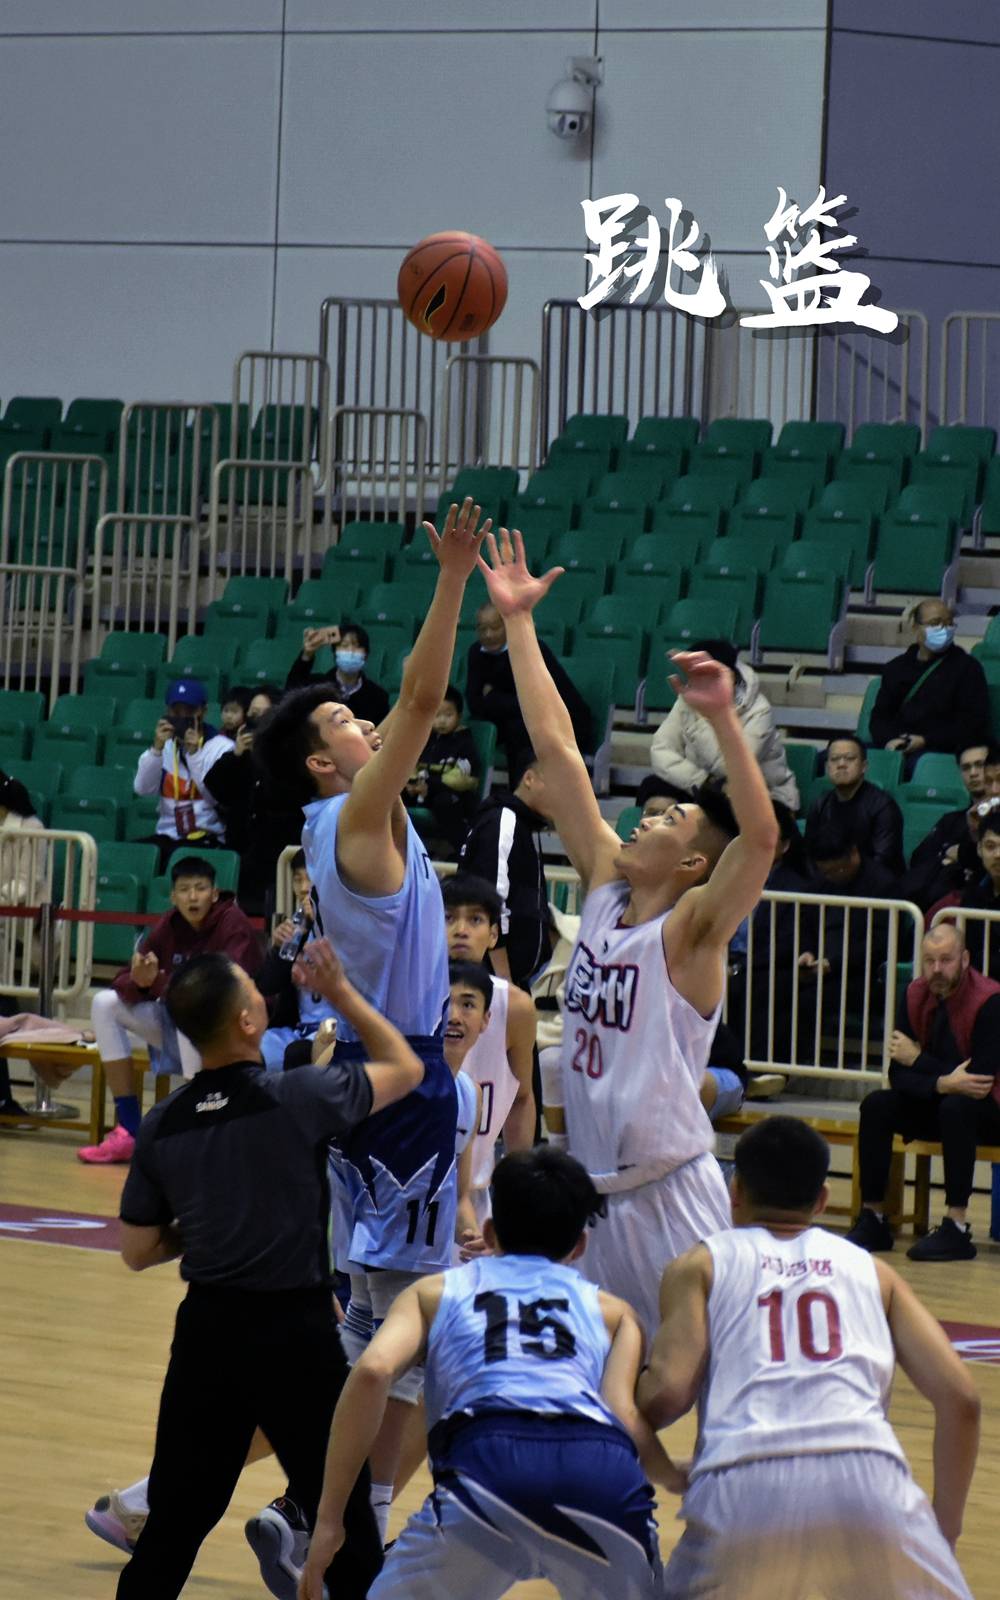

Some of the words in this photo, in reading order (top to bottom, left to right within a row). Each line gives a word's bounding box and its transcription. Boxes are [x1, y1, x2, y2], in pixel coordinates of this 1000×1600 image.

[571, 1028, 603, 1079] 20
[406, 1199, 439, 1247] 11
[473, 1290, 577, 1365] 15
[757, 1288, 843, 1363] 10
